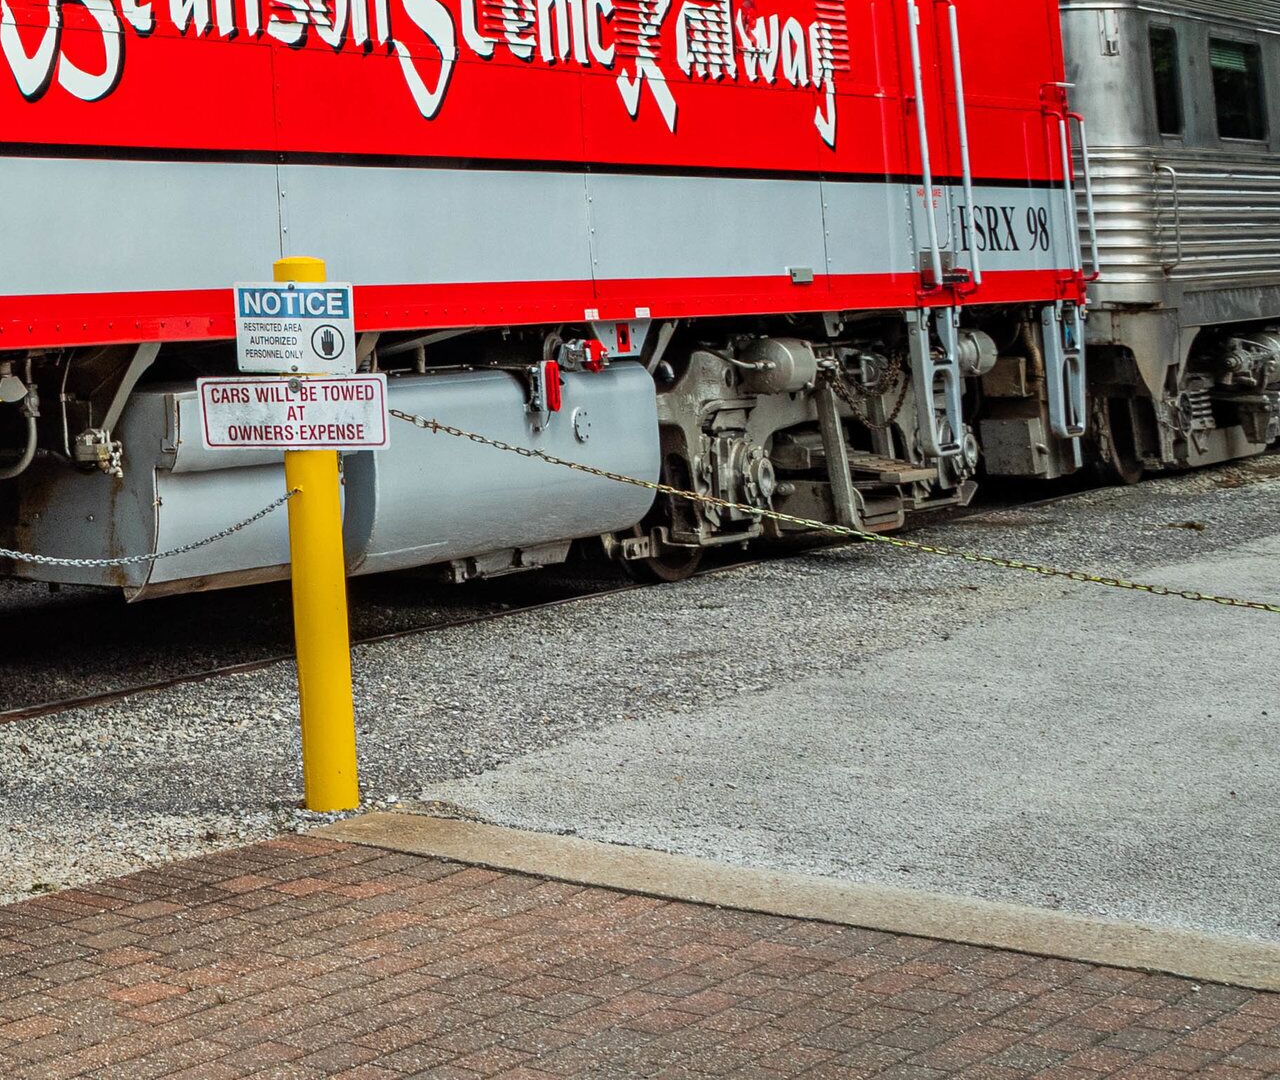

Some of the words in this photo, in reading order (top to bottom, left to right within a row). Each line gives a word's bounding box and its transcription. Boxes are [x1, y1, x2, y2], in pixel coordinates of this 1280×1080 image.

[1026, 206, 1050, 252] 98
[243, 291, 344, 316] NOTICE
[243, 322, 283, 333] RESTRICTED
[284, 322, 303, 333] AREA
[249, 336, 298, 346] AUTHORIZED
[245, 349, 284, 360] PERSONNEL
[284, 349, 304, 360] ONLY
[210, 386, 251, 404] CARS
[254, 386, 295, 403] WILL
[299, 385, 318, 402] BE
[321, 384, 375, 401] TOWED
[286, 405, 307, 422] AT
[228, 425, 294, 441] OWNERS
[299, 424, 365, 440] EXPENSE
